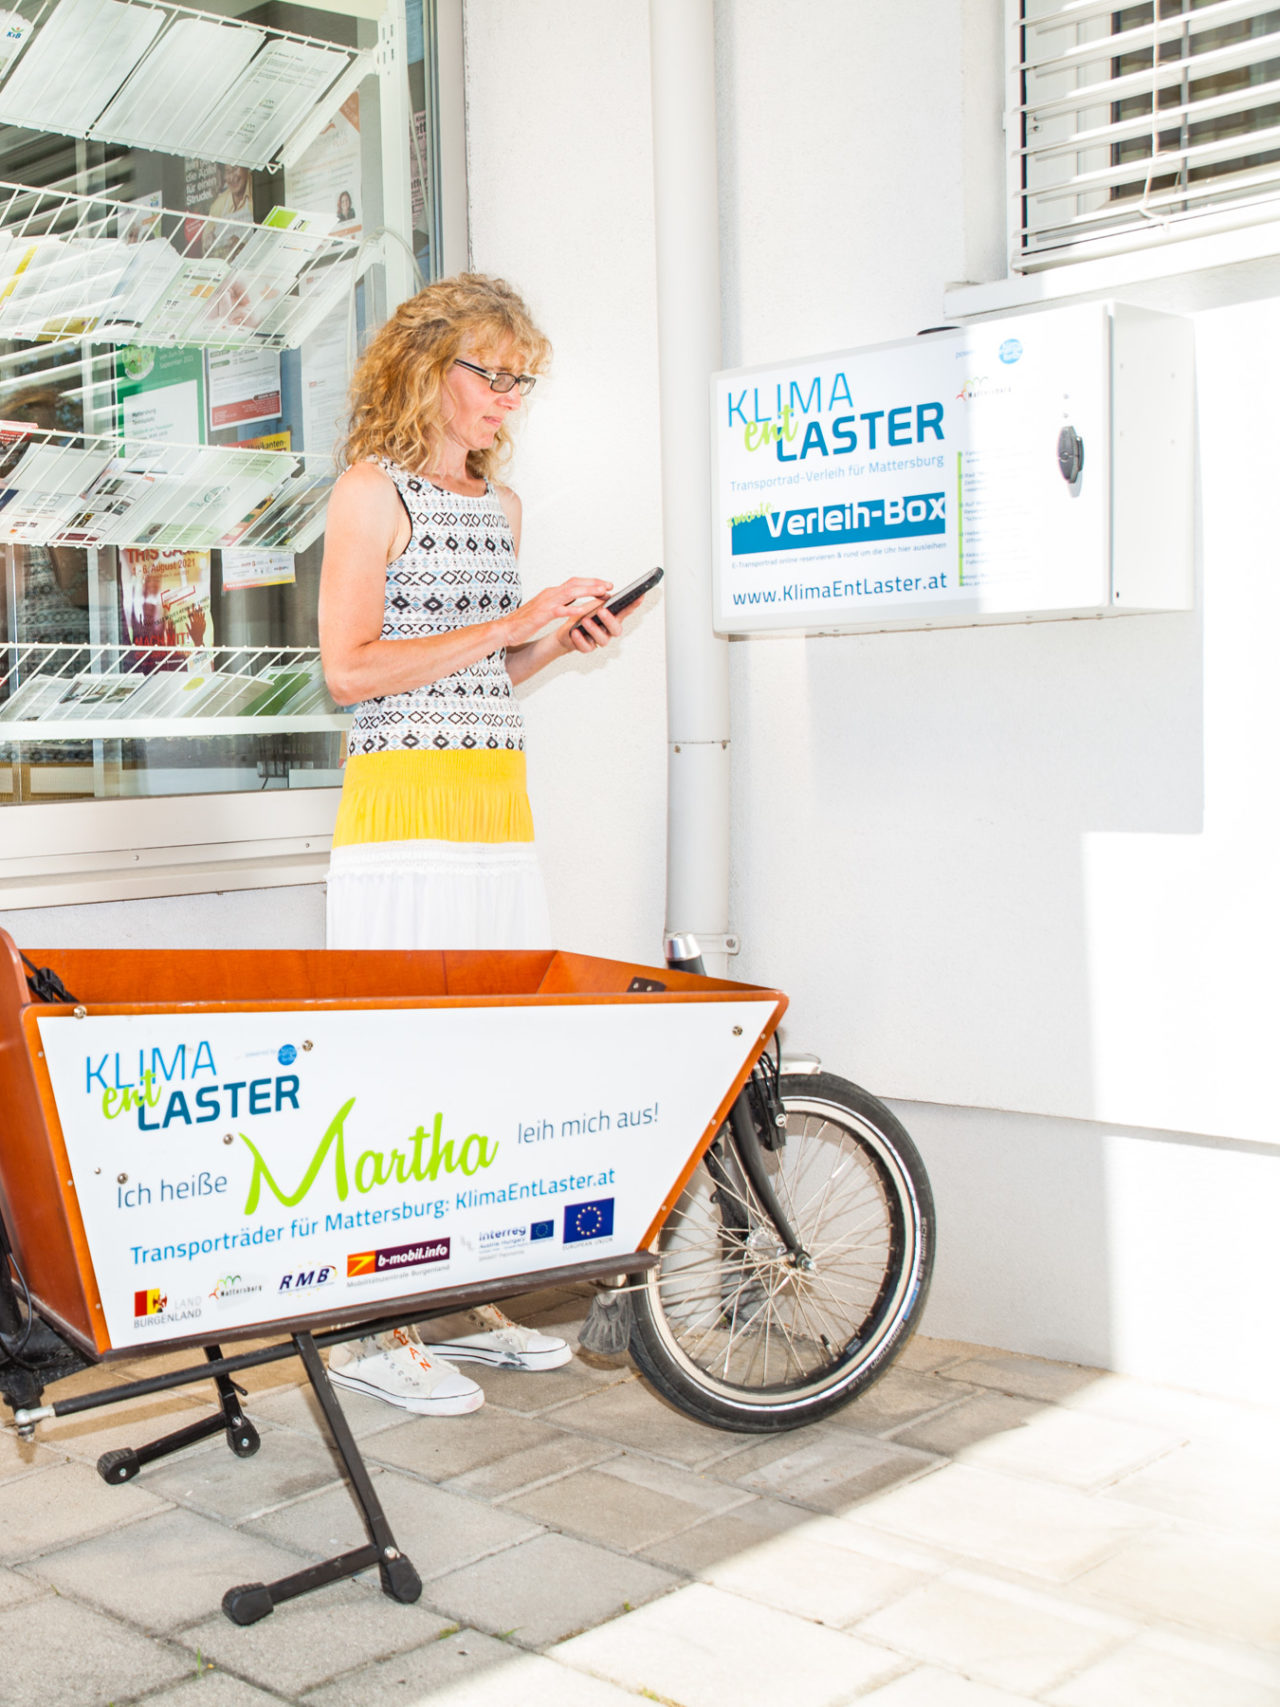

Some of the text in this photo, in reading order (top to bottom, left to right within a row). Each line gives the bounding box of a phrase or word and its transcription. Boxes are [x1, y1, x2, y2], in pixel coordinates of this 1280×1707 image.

[728, 372, 854, 427] KLIMA
[744, 404, 800, 452] ent
[776, 402, 945, 462] LASTER
[730, 455, 945, 492] Transportrad-Verleih für Mattersburg
[765, 495, 947, 538] Verleih-Box
[732, 572, 948, 605] www.KlimaEntLaster.at
[86, 1041, 217, 1093] KLIMA
[102, 1069, 162, 1119] ent
[138, 1075, 300, 1131] LASTER
[117, 1097, 659, 1215] Ich heiße Martha leih mich aus!
[130, 1168, 616, 1266] Transporträder für Mattersburg: KlimaEntLaster.at
[377, 1244, 448, 1266] b-mobil.info
[133, 1308, 202, 1329] BURGENLAND
